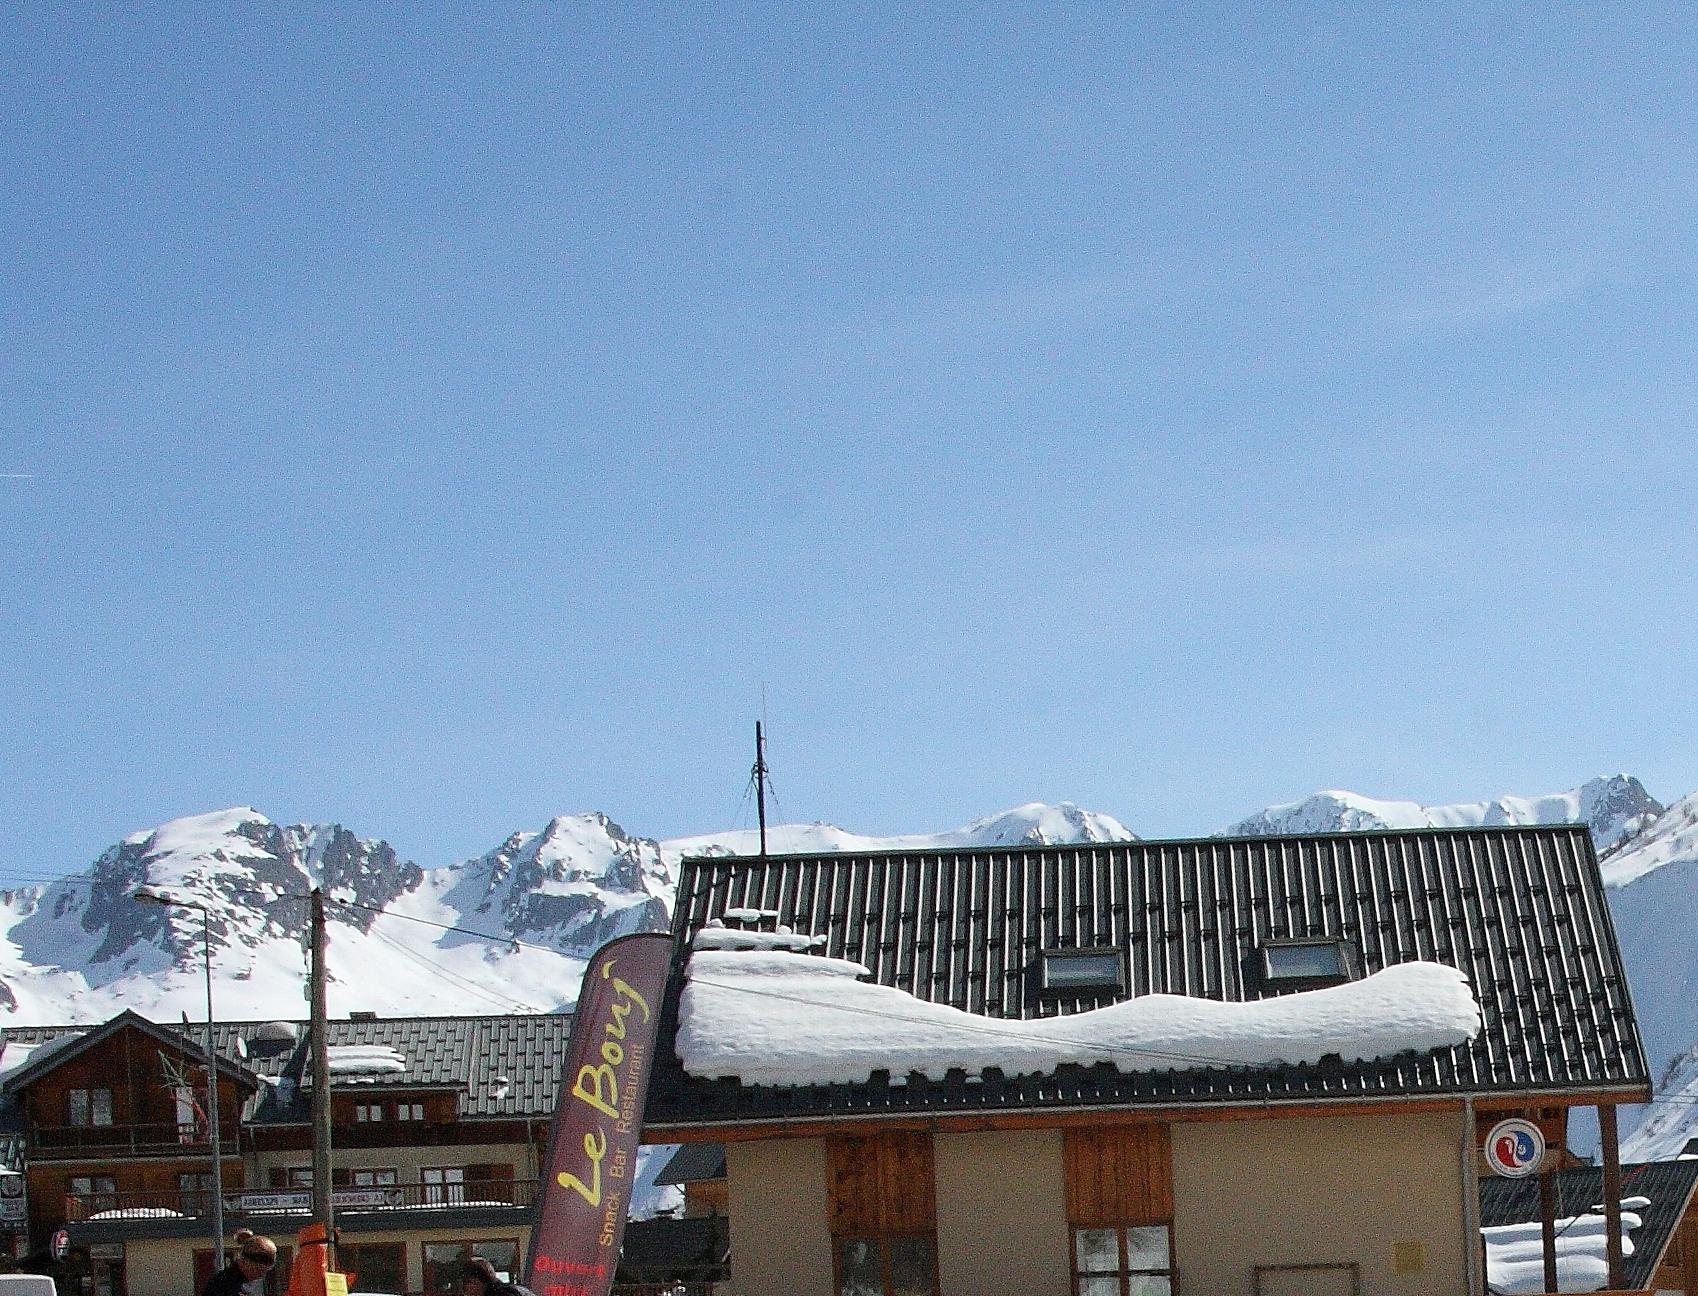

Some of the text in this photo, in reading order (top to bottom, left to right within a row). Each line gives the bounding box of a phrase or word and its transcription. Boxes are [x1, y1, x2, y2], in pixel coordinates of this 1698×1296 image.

[556, 1126, 607, 1207] Le
[600, 1042, 645, 1247] Snack Bar Restaurant
